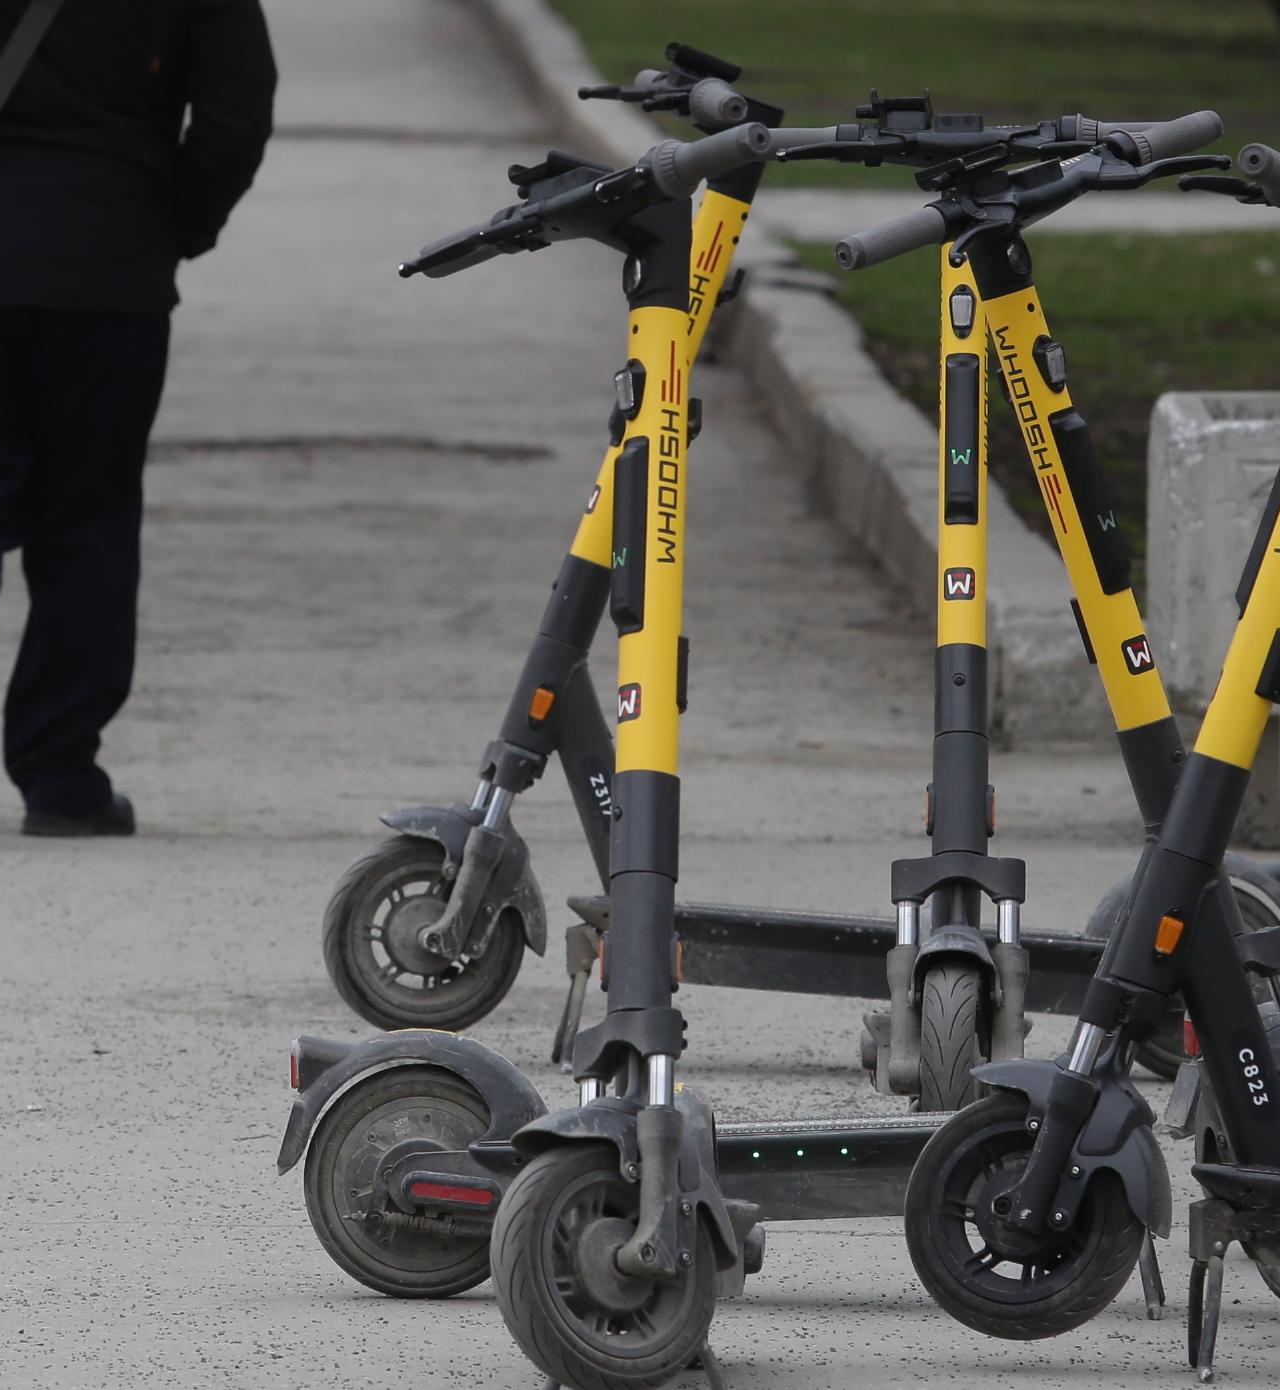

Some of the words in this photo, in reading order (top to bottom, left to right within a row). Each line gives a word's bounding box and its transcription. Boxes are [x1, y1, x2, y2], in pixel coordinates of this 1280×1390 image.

[995, 325, 1053, 470] WHOOSH
[951, 448, 971, 465] W
[656, 408, 680, 564] WHOOSH
[1097, 510, 1116, 531] W
[947, 573, 971, 595] W
[1126, 640, 1151, 668] W
[1238, 1047, 1269, 1106] C823
